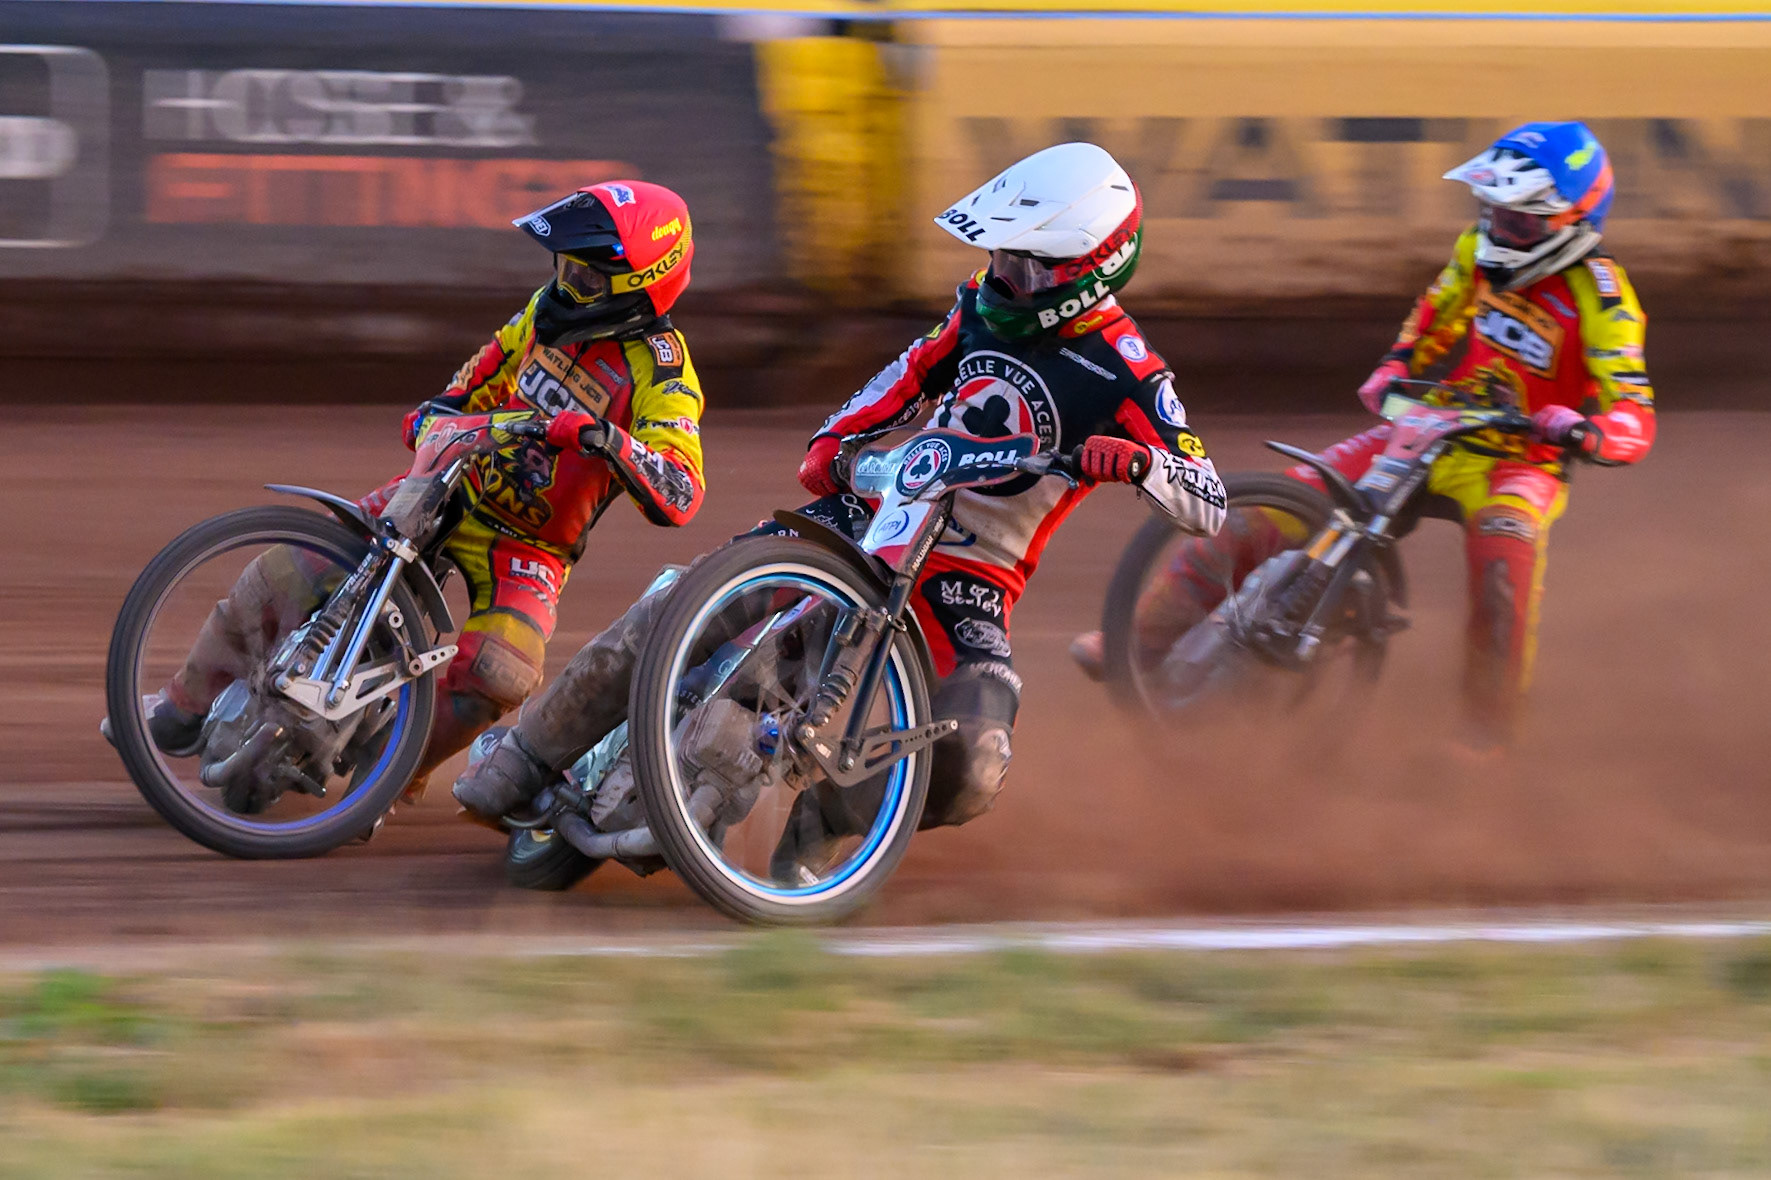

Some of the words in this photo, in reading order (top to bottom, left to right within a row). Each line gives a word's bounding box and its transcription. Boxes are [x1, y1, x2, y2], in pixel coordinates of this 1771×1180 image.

[938, 208, 987, 243] BOLL
[626, 241, 684, 289] OAKLEY
[1036, 280, 1111, 330] BOLL
[651, 336, 674, 363] JCB
[579, 381, 604, 405] JCB
[954, 359, 995, 388] BELLE
[1003, 364, 1036, 395] VUE
[1030, 399, 1053, 445] ACES
